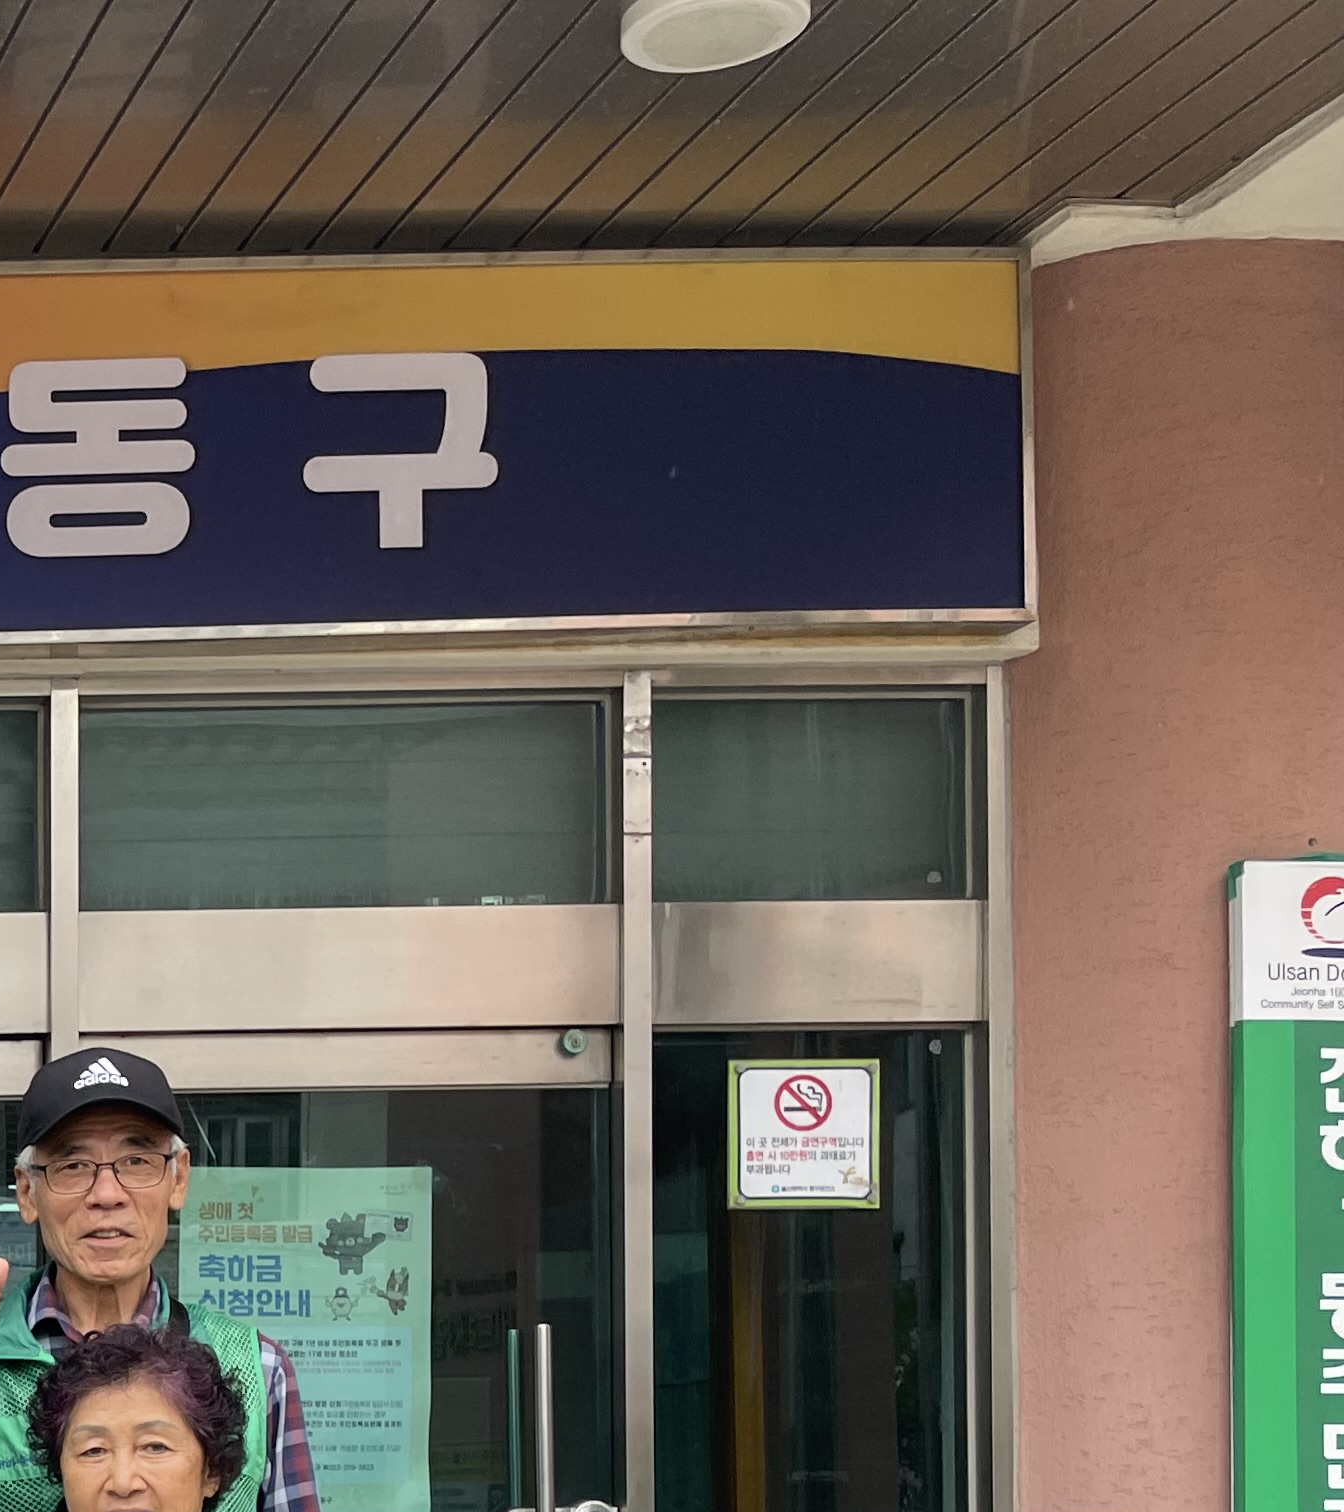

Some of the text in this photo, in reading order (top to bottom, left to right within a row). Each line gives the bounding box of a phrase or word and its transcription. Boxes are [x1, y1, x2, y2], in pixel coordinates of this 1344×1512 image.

[0, 351, 499, 558] 동구
[1268, 963, 1344, 981] Ulsan D
[1260, 1000, 1314, 1010] Community
[1317, 1000, 1334, 1010] Self
[74, 1073, 129, 1090] adidas
[746, 1137, 864, 1149] 이 곳 전체가 금연구역입니다
[746, 1151, 856, 1162] 흡연 시 10만원의 과태료가
[746, 1165, 791, 1176] 부과됩니다
[199, 1202, 254, 1221] 생애 첫
[198, 1224, 313, 1243] 주민등록증 발급
[198, 1254, 282, 1283] 축하금
[198, 1289, 311, 1318] 신청안내
